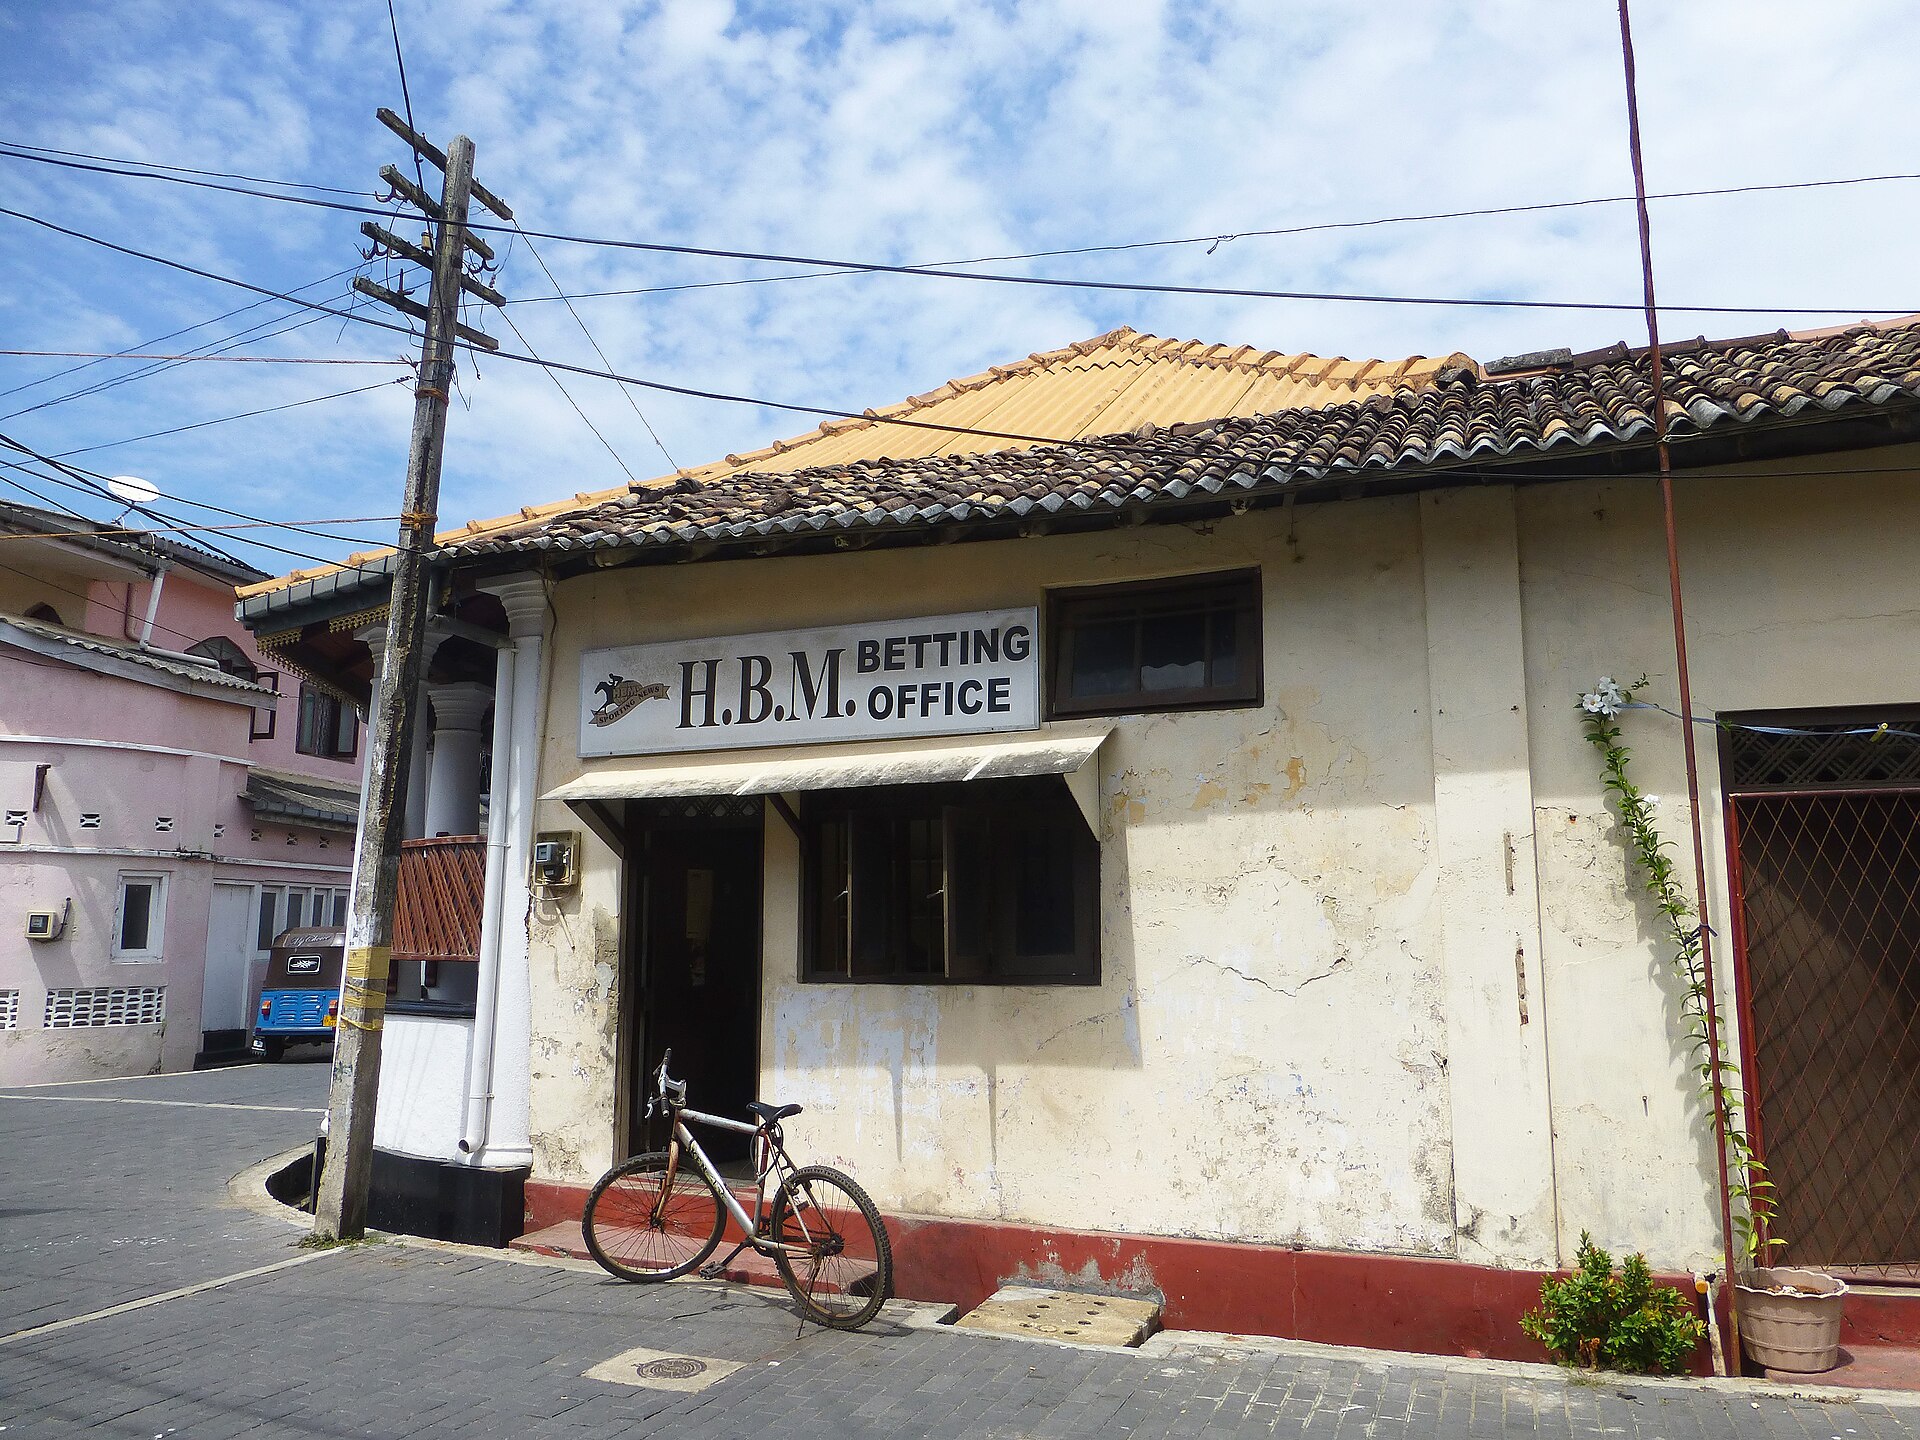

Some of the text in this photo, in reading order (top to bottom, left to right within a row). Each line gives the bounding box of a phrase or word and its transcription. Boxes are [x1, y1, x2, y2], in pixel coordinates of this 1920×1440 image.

[857, 625, 1030, 673] BETTING
[599, 686, 660, 723] SPORTING NEWS
[675, 648, 857, 729] H.B.M.
[867, 677, 1011, 720] OFFICE
